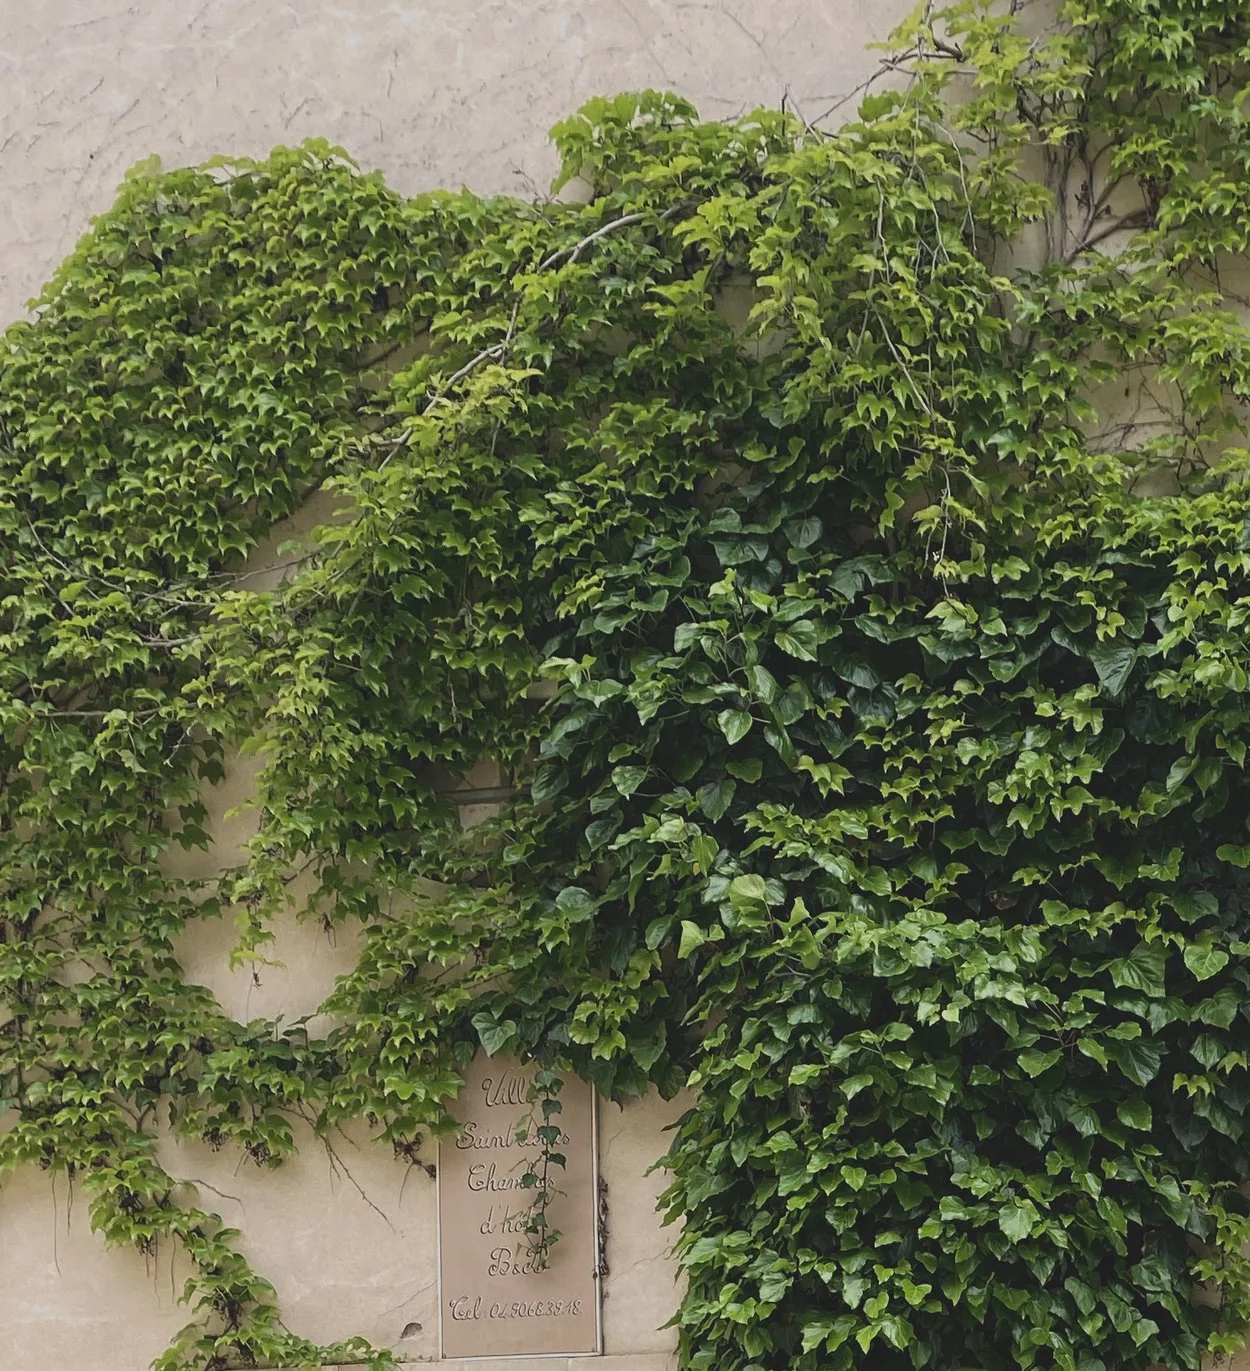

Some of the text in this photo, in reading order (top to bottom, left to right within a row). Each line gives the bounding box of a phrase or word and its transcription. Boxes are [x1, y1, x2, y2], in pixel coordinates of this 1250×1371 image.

[481, 1067, 536, 1108] Vill
[456, 1120, 515, 1150] Saint
[467, 1162, 555, 1192] Chames
